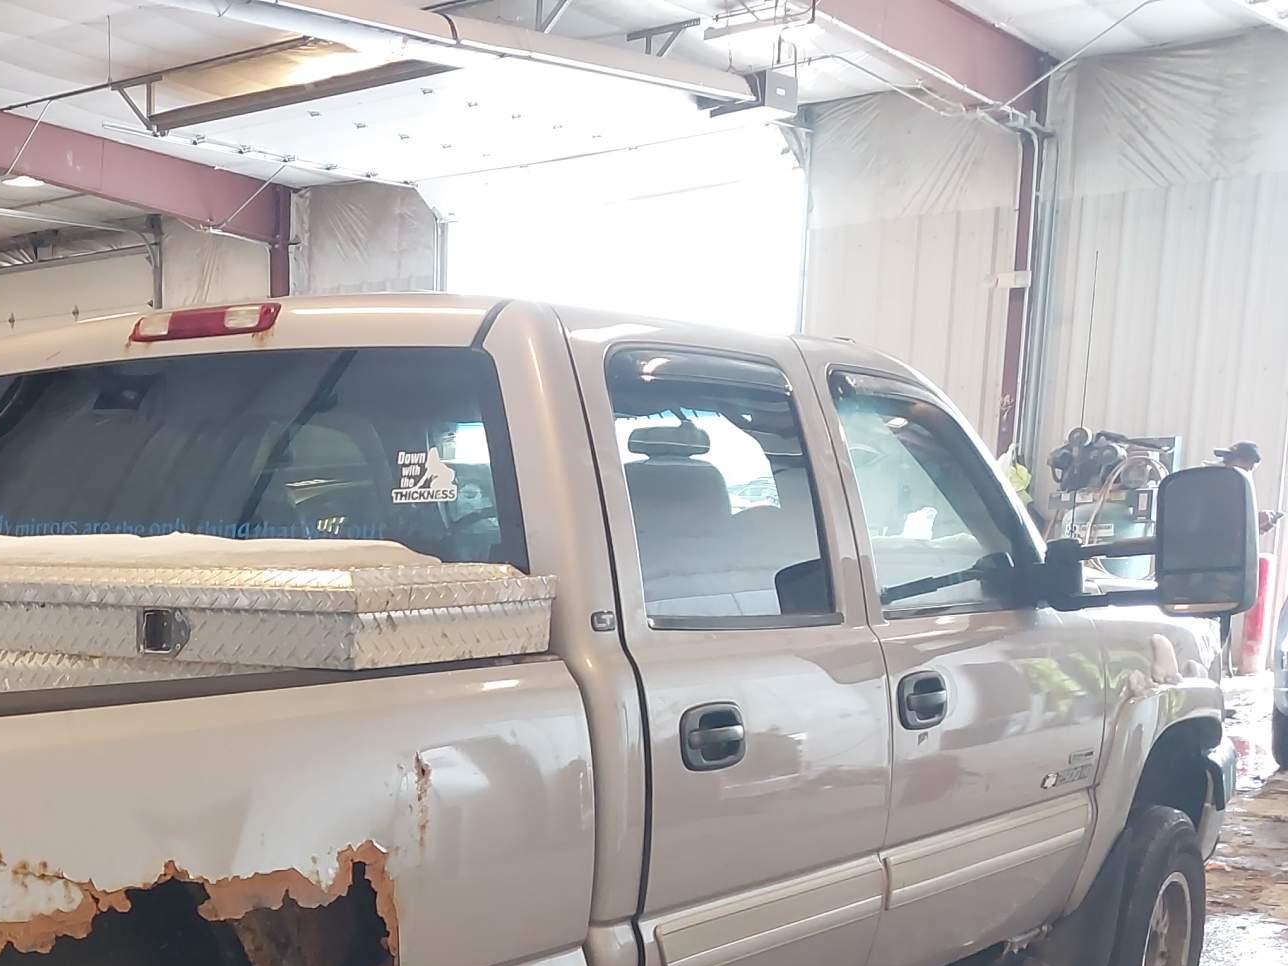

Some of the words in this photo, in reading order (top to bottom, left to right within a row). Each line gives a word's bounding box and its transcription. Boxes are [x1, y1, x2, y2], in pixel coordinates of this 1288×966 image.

[397, 451, 426, 465] Down
[402, 464, 421, 477] with
[400, 477, 415, 488] the
[393, 489, 456, 501] THICKNESS
[15, 518, 78, 537] mirrors
[85, 521, 111, 535] are
[114, 519, 145, 537] the
[593, 614, 614, 629] LT
